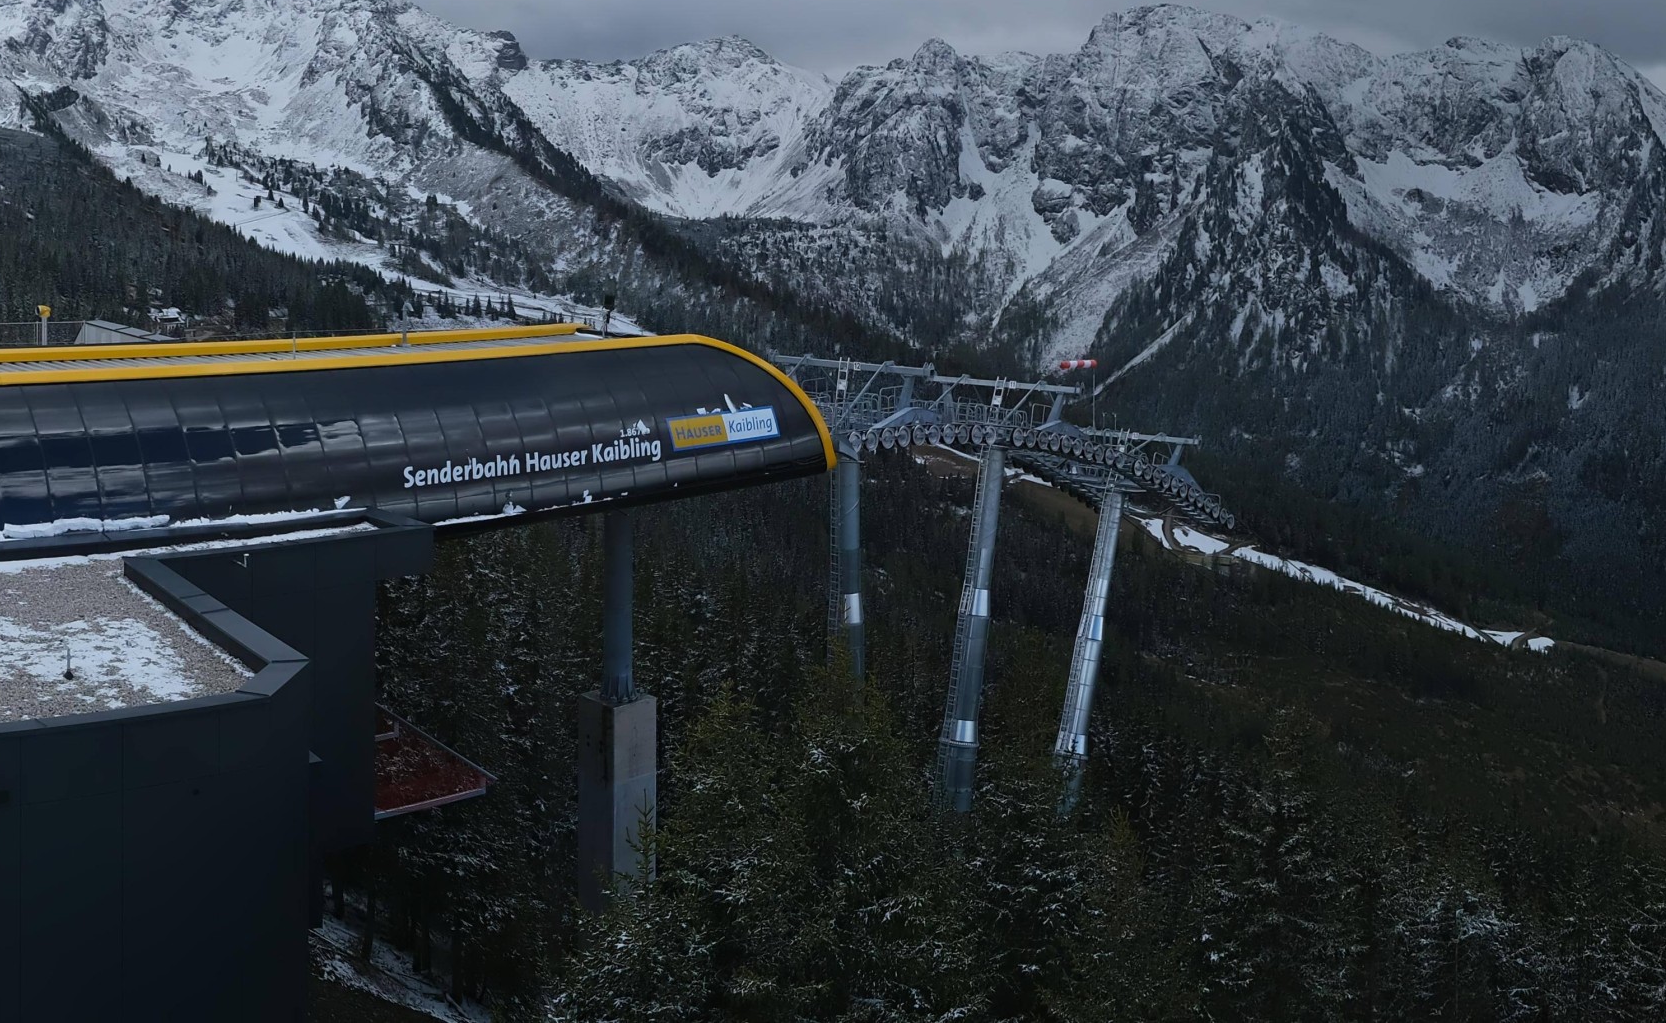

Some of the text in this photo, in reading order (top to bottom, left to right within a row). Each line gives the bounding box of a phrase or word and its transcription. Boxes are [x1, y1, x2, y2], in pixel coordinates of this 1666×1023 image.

[675, 416, 773, 440] HAUSER Kaibling
[403, 437, 661, 488] Senderbahn Hauser Kaibling
